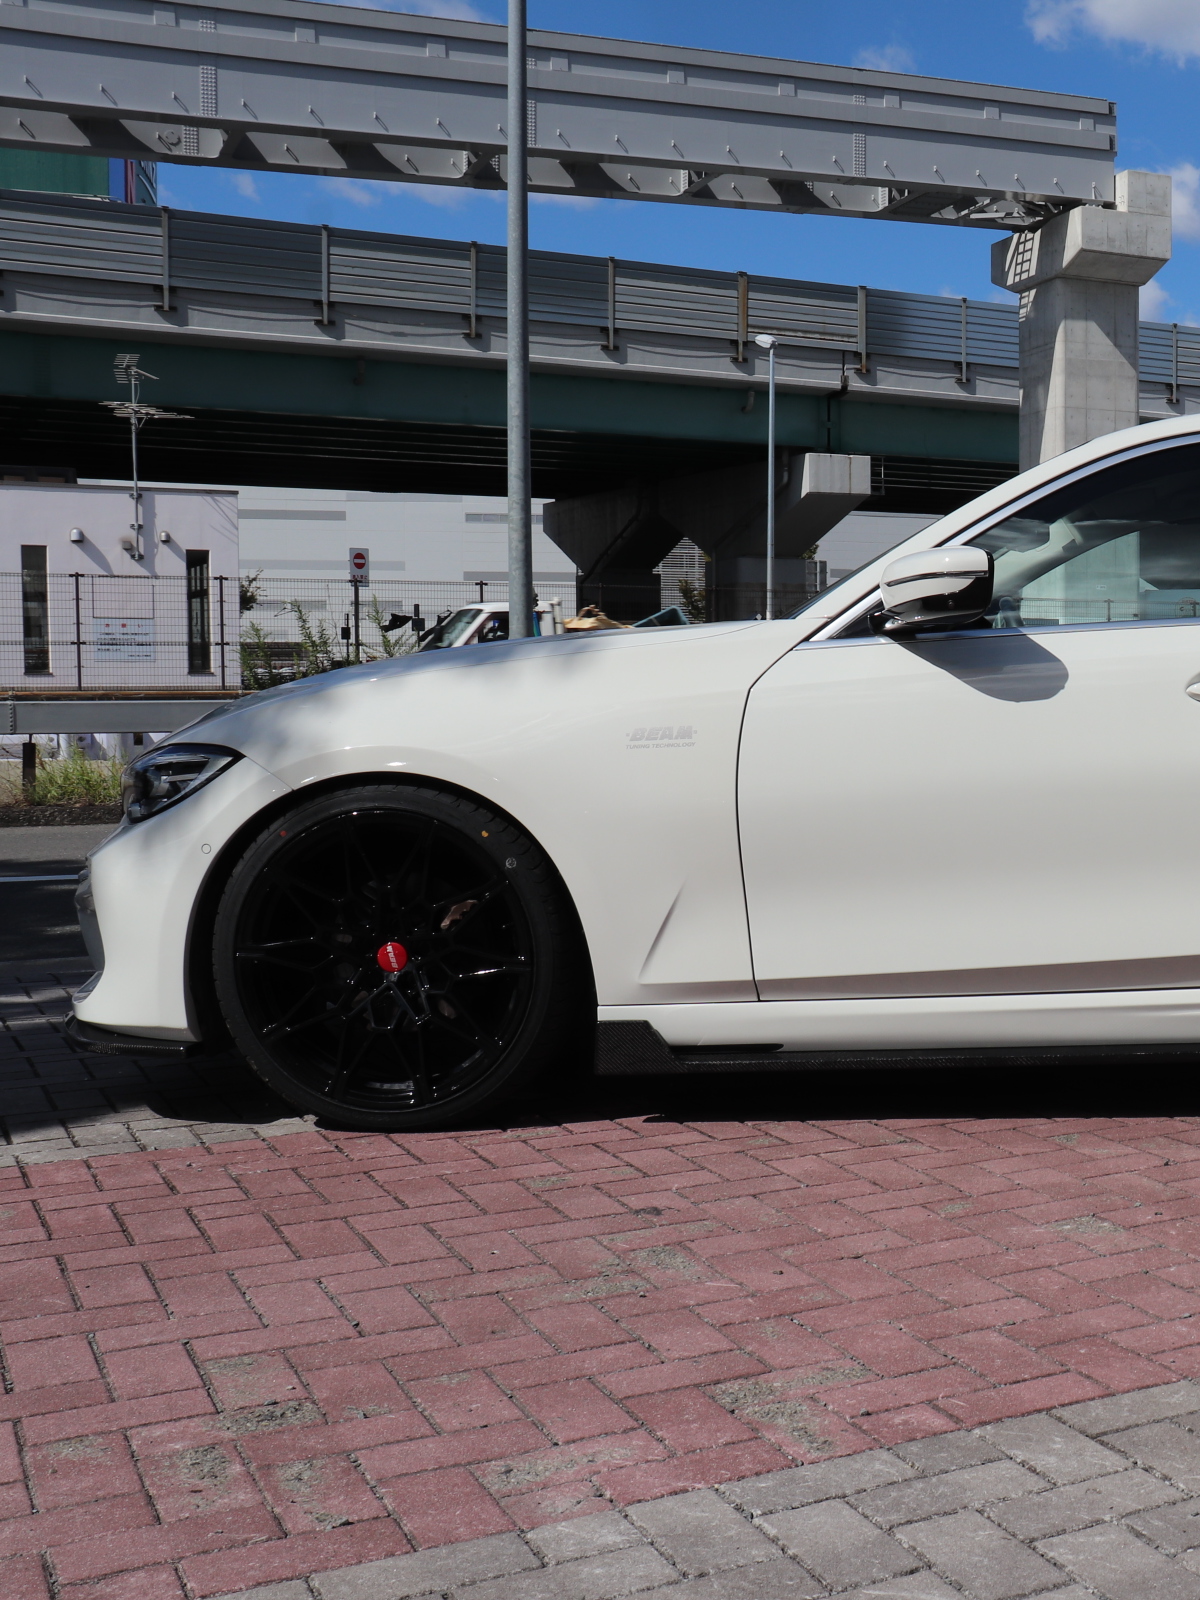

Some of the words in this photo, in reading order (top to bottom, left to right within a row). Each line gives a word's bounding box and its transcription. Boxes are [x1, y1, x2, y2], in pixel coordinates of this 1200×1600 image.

[629, 725, 693, 742] BEAM
[625, 743, 651, 751] TUNING
[652, 741, 697, 750] TECHNOLOGY
